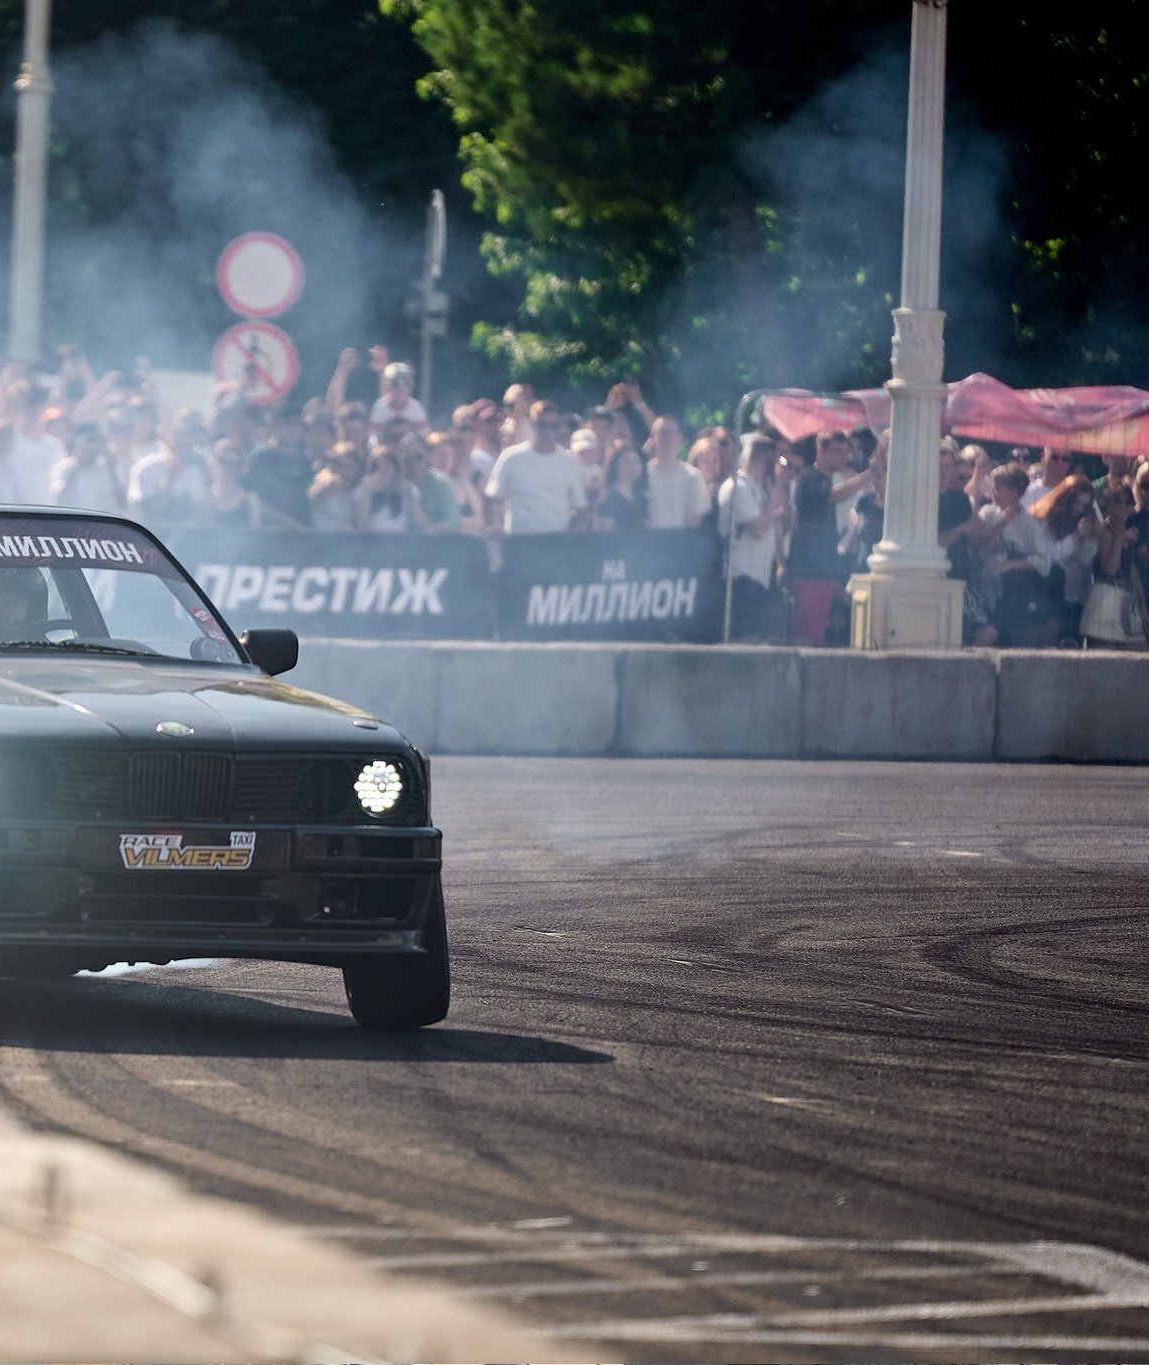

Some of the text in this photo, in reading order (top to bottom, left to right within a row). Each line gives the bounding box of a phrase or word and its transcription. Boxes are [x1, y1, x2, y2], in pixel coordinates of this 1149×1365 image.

[195, 563, 451, 616] ПРЕСТИЖ
[526, 577, 699, 626] МИЛЛИОН
[122, 834, 253, 848] RACE TAXI
[125, 848, 251, 867] VILMERS
